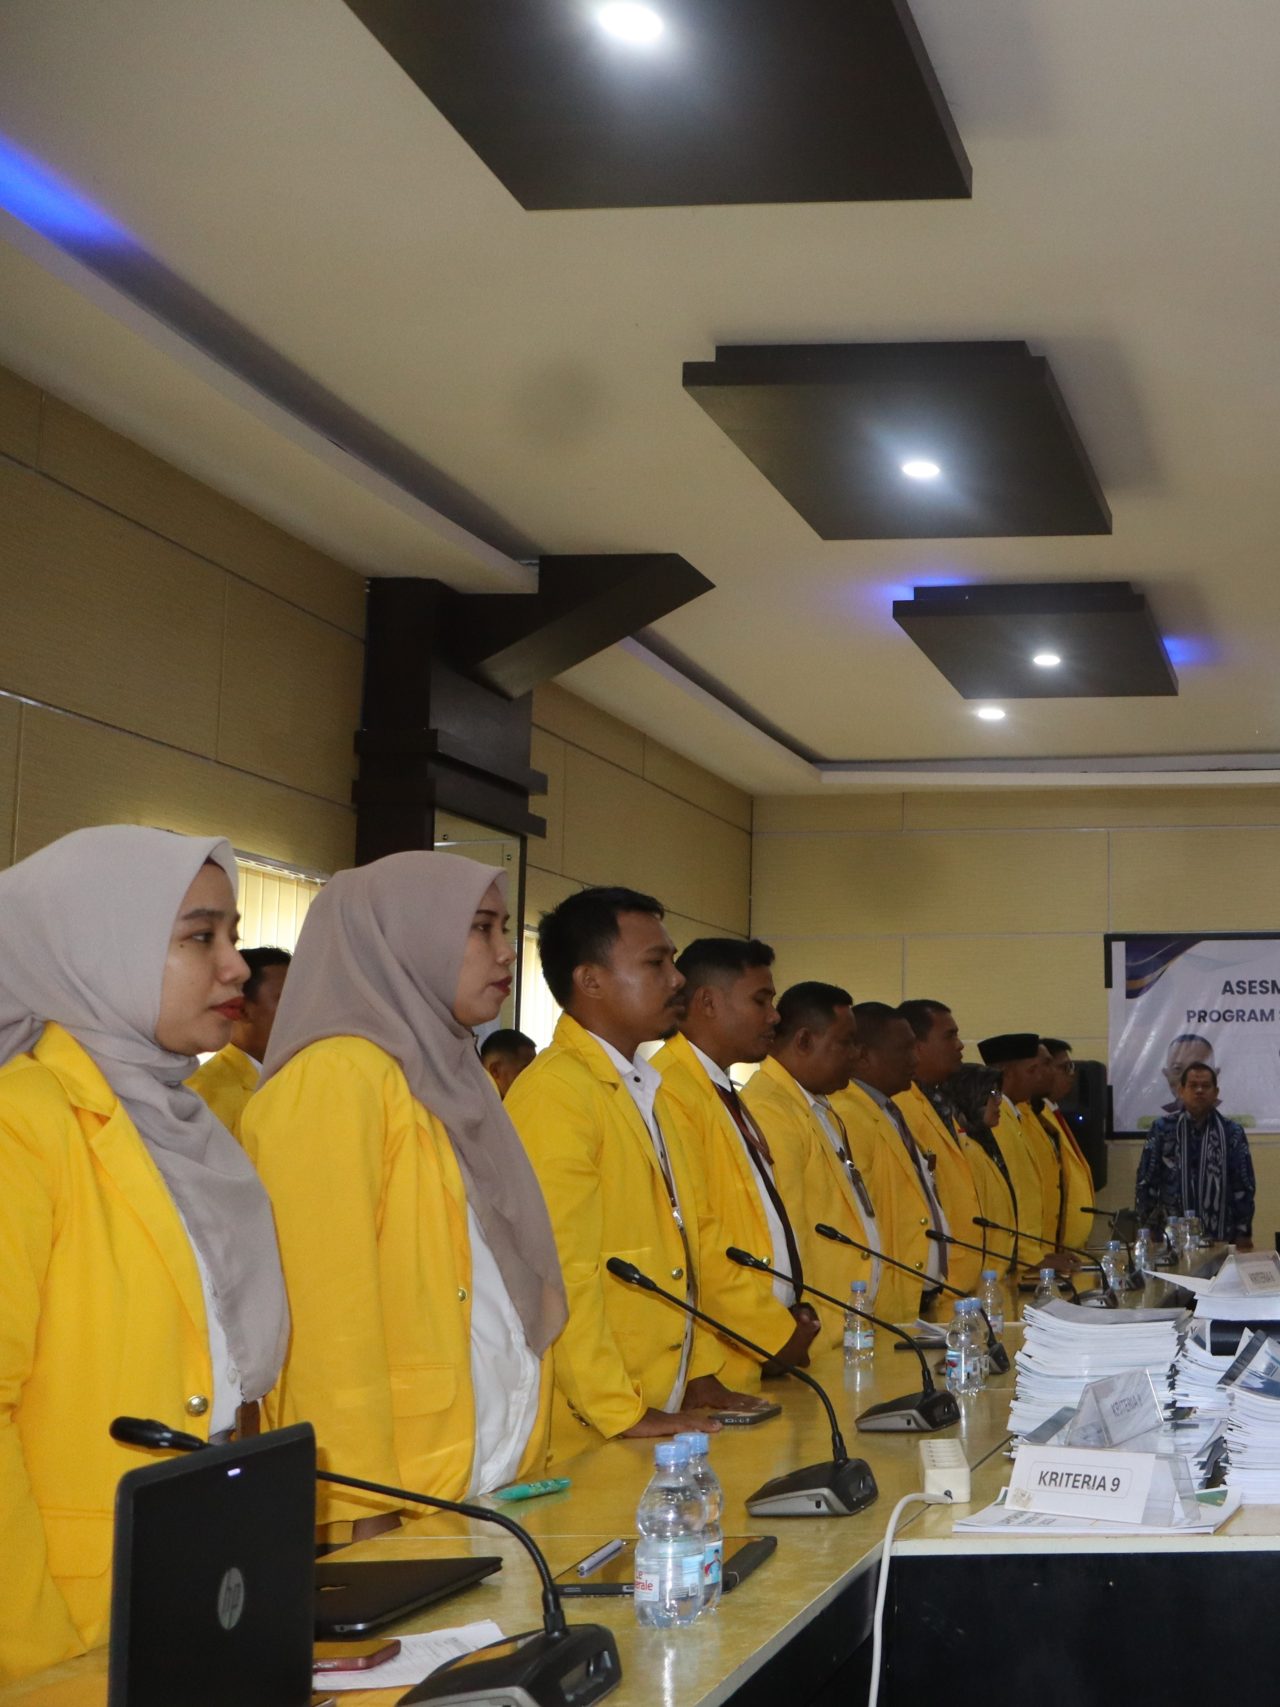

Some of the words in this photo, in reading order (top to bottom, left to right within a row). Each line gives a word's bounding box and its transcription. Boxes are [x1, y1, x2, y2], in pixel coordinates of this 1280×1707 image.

[1186, 1008, 1275, 1023] PROGRAM
[1038, 1470, 1107, 1492] KRITERIA
[1110, 1477, 1121, 1492] 9
